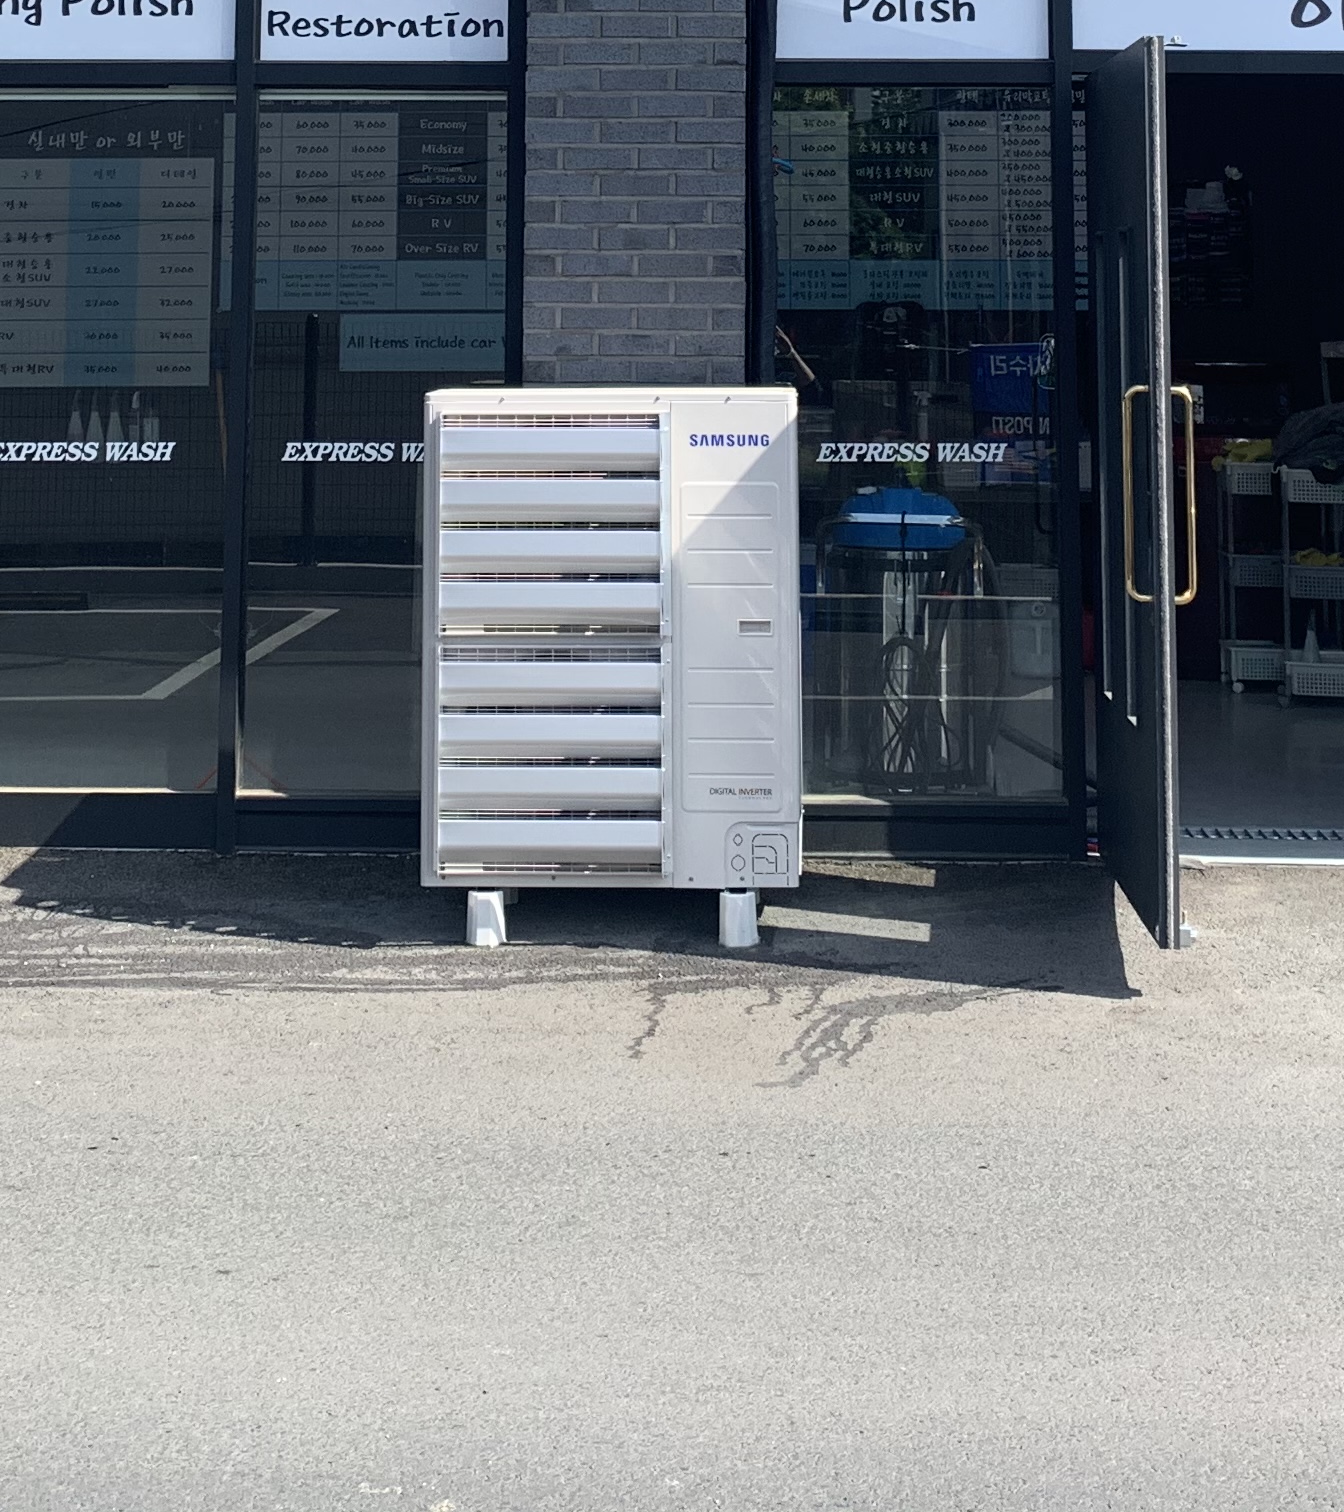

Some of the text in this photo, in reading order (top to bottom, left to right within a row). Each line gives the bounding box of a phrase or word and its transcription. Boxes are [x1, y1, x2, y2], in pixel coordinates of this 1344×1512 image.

[268, 10, 504, 38] Restoration
[419, 119, 467, 131] Economy
[28, 129, 185, 152] 실내만 or 외부만
[421, 144, 465, 155] Midsize
[458, 174, 477, 184] SUV
[456, 194, 479, 205] SUV
[405, 243, 479, 254] Over Size RV
[347, 335, 364, 349] All
[415, 335, 465, 349] include
[471, 339, 497, 349] car
[689, 434, 769, 447] SAMSUNG
[103, 441, 176, 462] WASH
[281, 442, 396, 463] EXPRESS
[816, 442, 1008, 463] EXPRESS WASH
[709, 787, 773, 796] DIGITAL INVERTER
